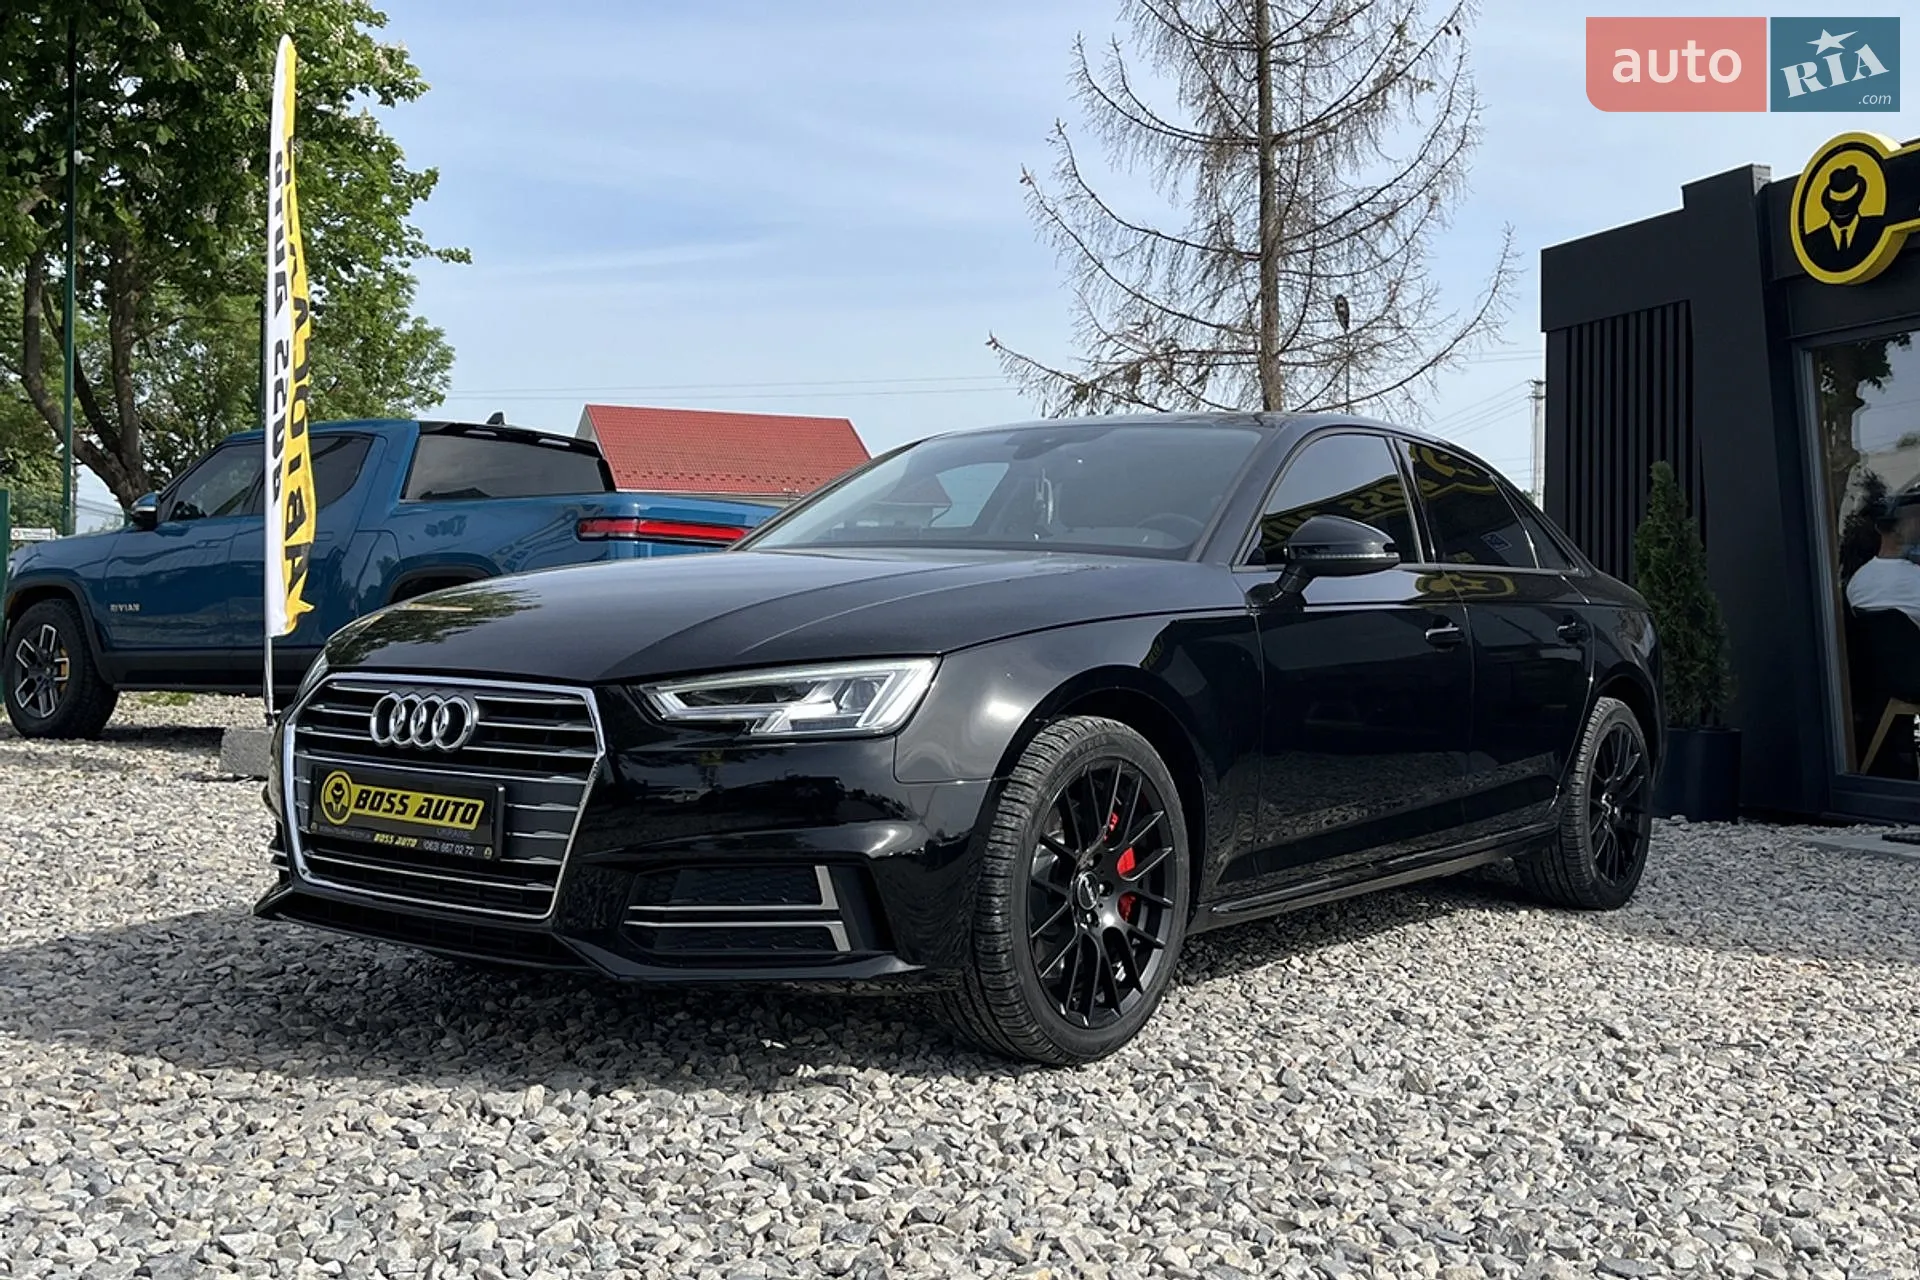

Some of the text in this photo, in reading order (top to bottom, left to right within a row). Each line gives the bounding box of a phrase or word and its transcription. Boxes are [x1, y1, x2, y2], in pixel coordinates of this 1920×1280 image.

[110, 602, 141, 612] RIVIAN
[354, 789, 481, 825] BOSS AUTO
[373, 833, 395, 845] BOSS
[394, 836, 418, 848] AUTO
